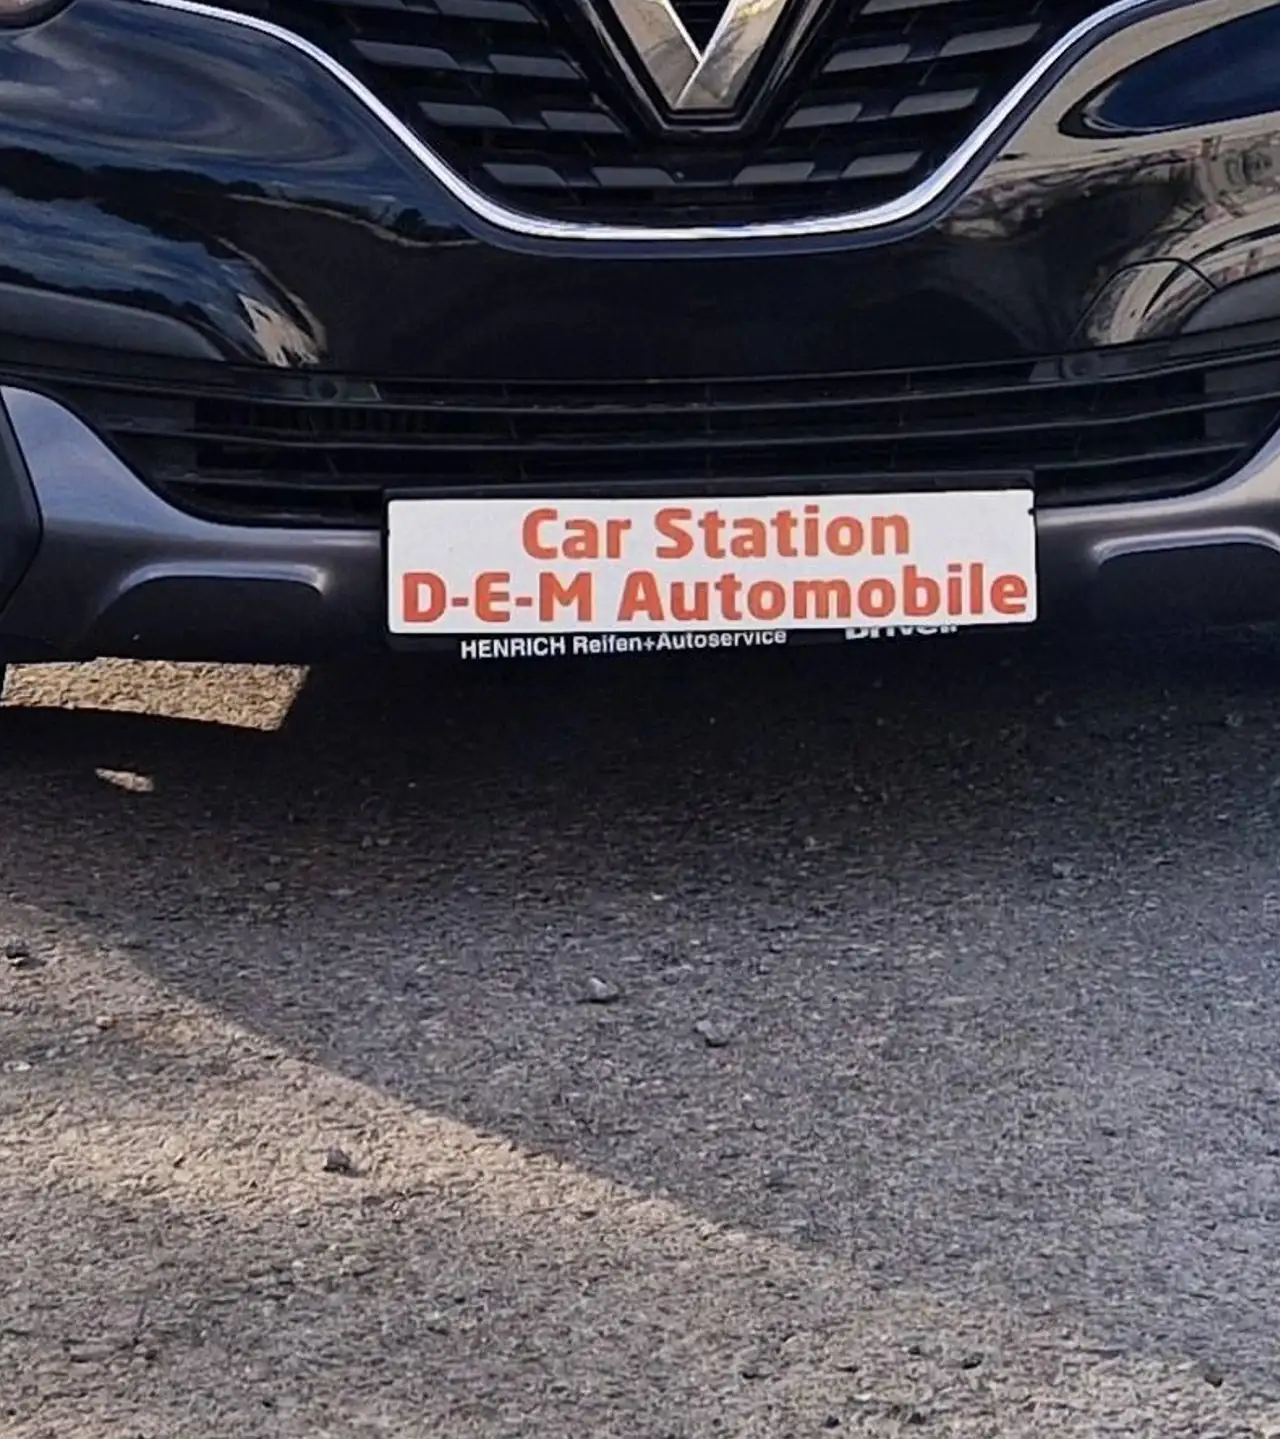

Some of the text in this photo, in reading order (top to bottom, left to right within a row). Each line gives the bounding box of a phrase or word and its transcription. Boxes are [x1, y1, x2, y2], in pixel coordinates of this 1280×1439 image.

[522, 504, 910, 560] Car Station
[402, 562, 1028, 623] D-E-M Automobile
[460, 629, 787, 659] HENRICH Reifen+Autoservice
